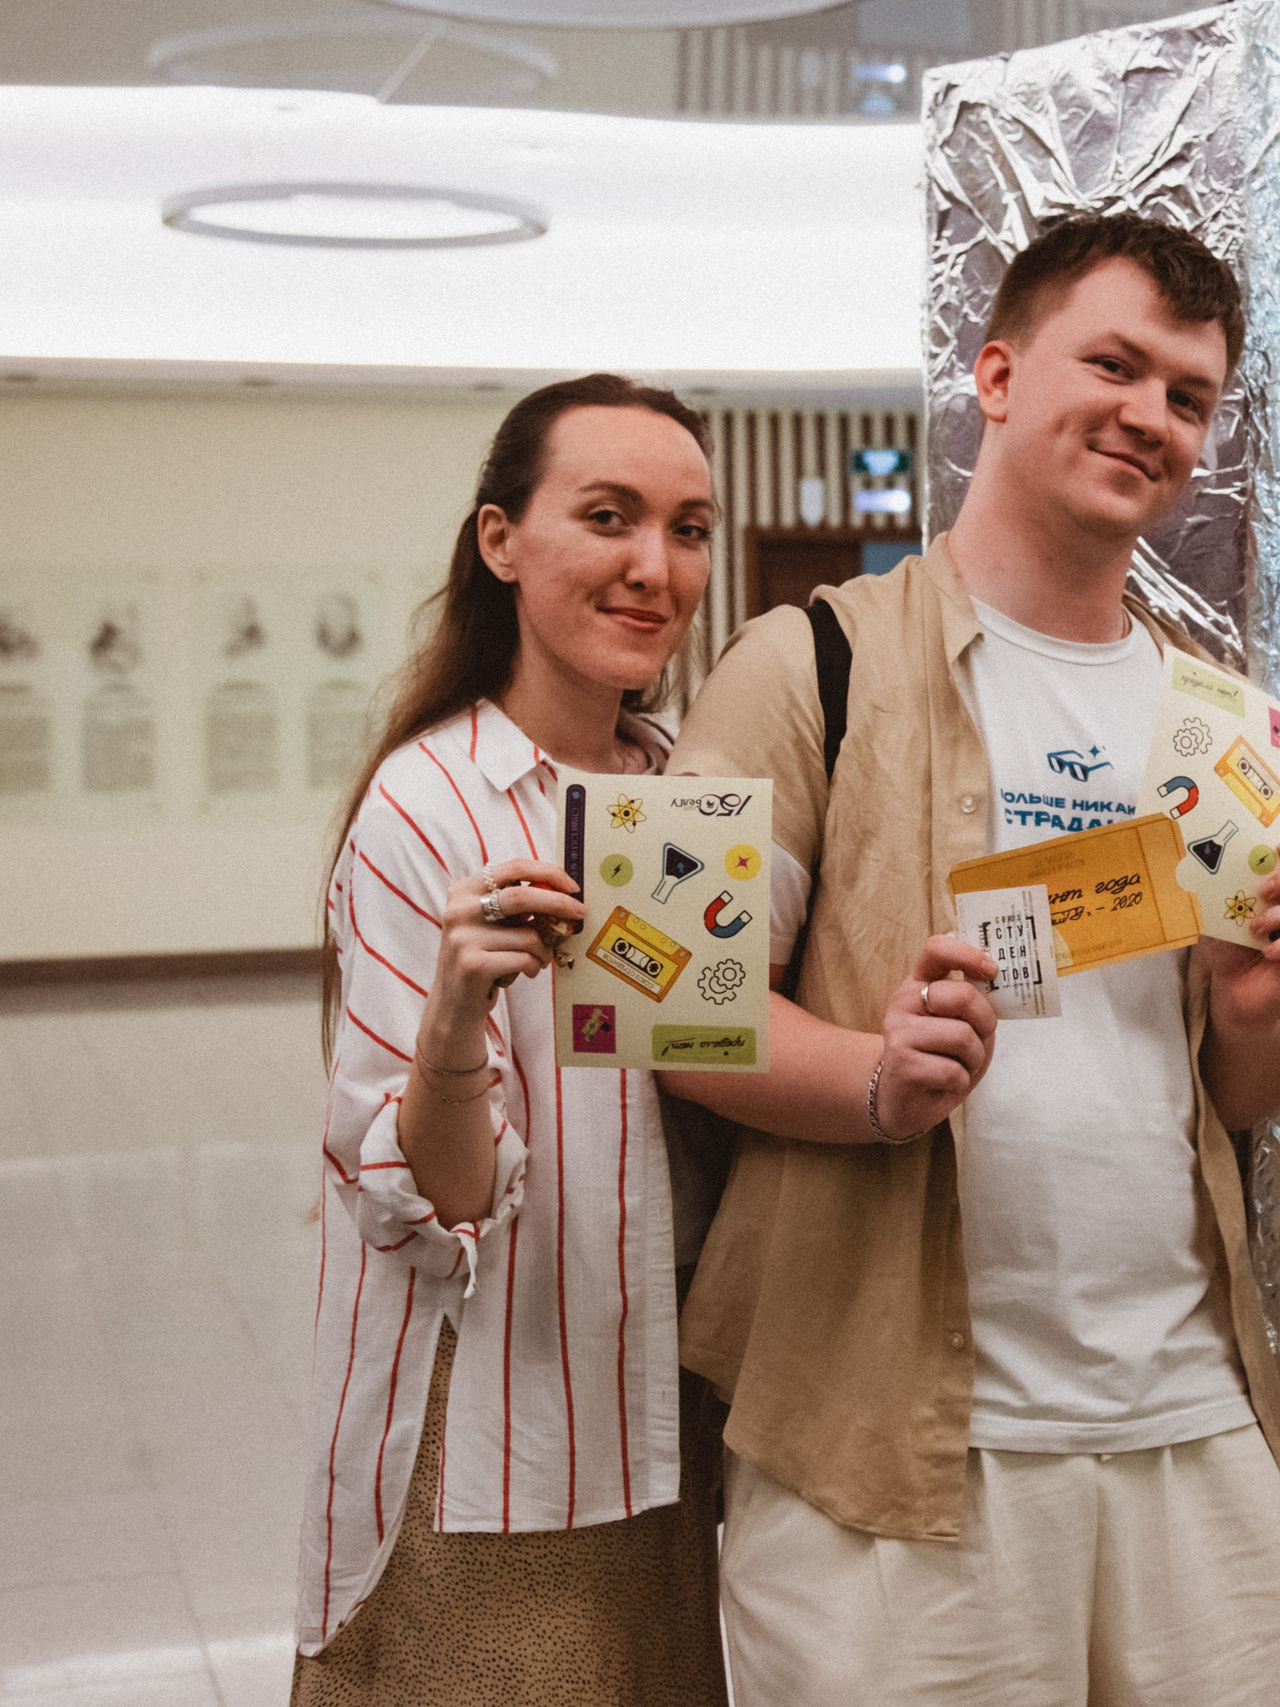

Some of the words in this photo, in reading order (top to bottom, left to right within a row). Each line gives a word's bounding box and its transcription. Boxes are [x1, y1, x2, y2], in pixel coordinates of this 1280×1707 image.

[671, 798, 702, 808] БелГУ
[1000, 788, 1066, 809] ОЛЬШЕ
[1071, 798, 1137, 816] НИКАК
[1004, 807, 1113, 833] СТРАДА
[1094, 873, 1141, 895] года
[995, 924, 1024, 940] СТУ
[998, 945, 1027, 961] ДЕН
[1001, 966, 1030, 982] ТОВ
